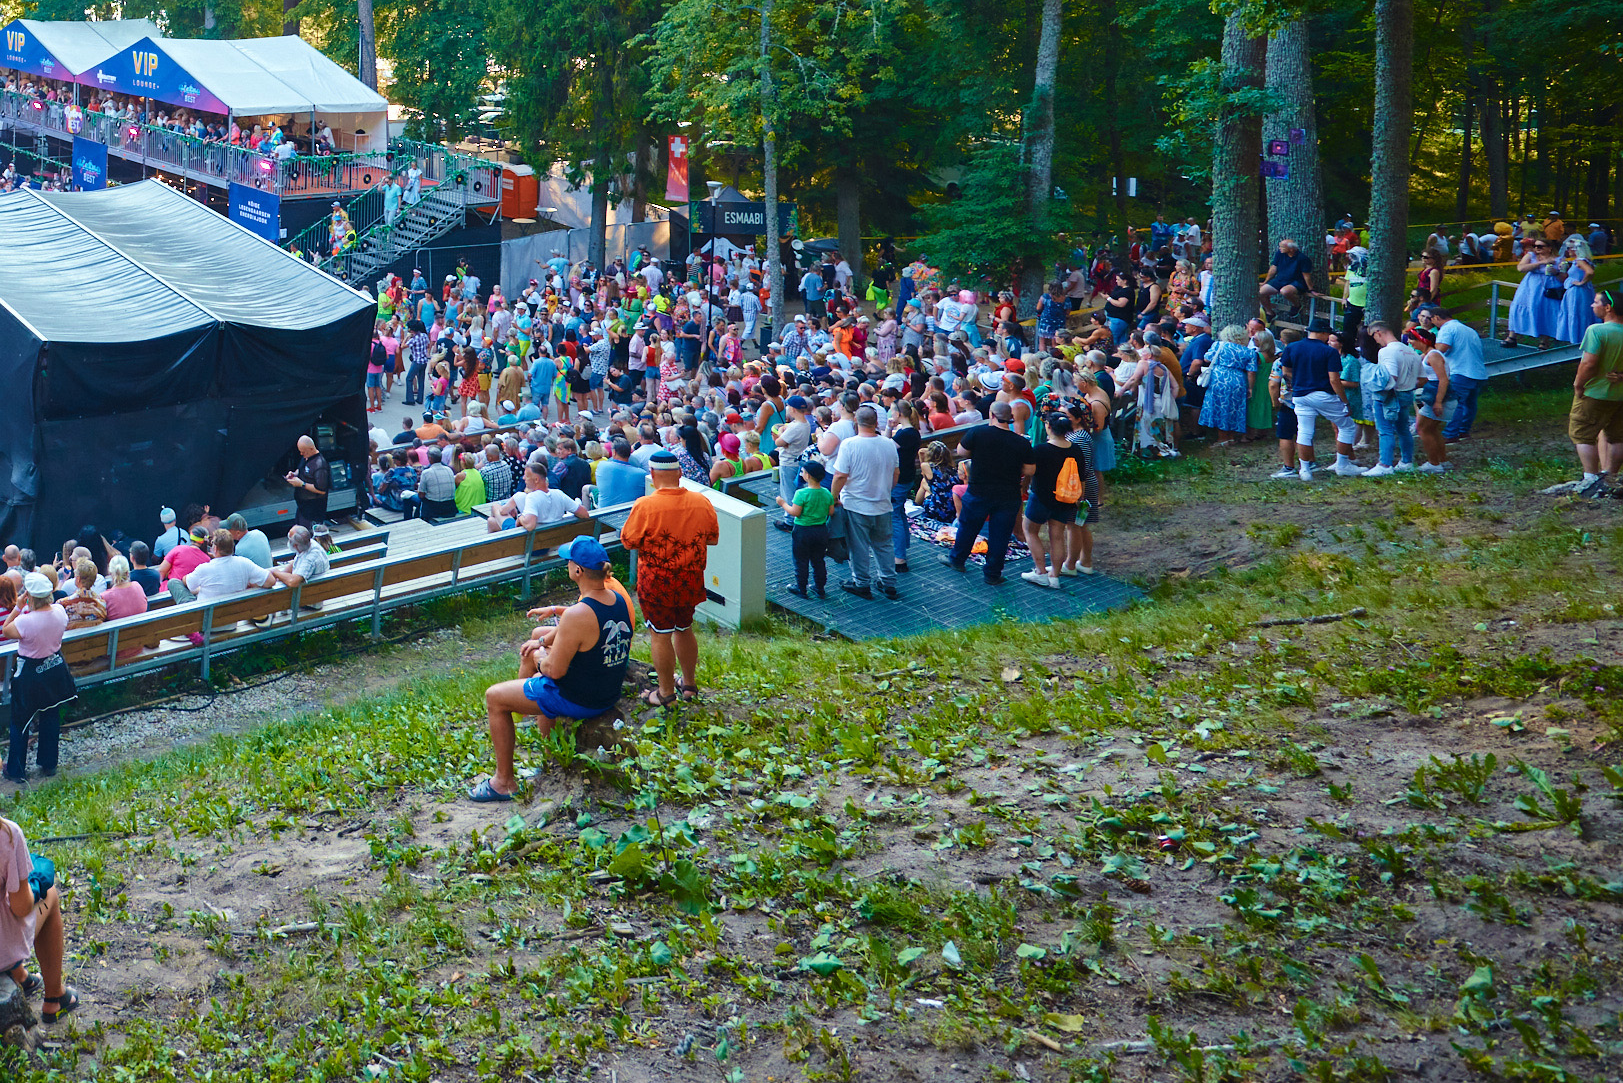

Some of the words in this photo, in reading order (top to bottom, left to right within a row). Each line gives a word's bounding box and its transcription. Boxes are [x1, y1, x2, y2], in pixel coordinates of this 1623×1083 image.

[7, 30, 25, 52] VIP
[133, 51, 158, 76] VIP
[725, 211, 763, 224] ESMAABI
